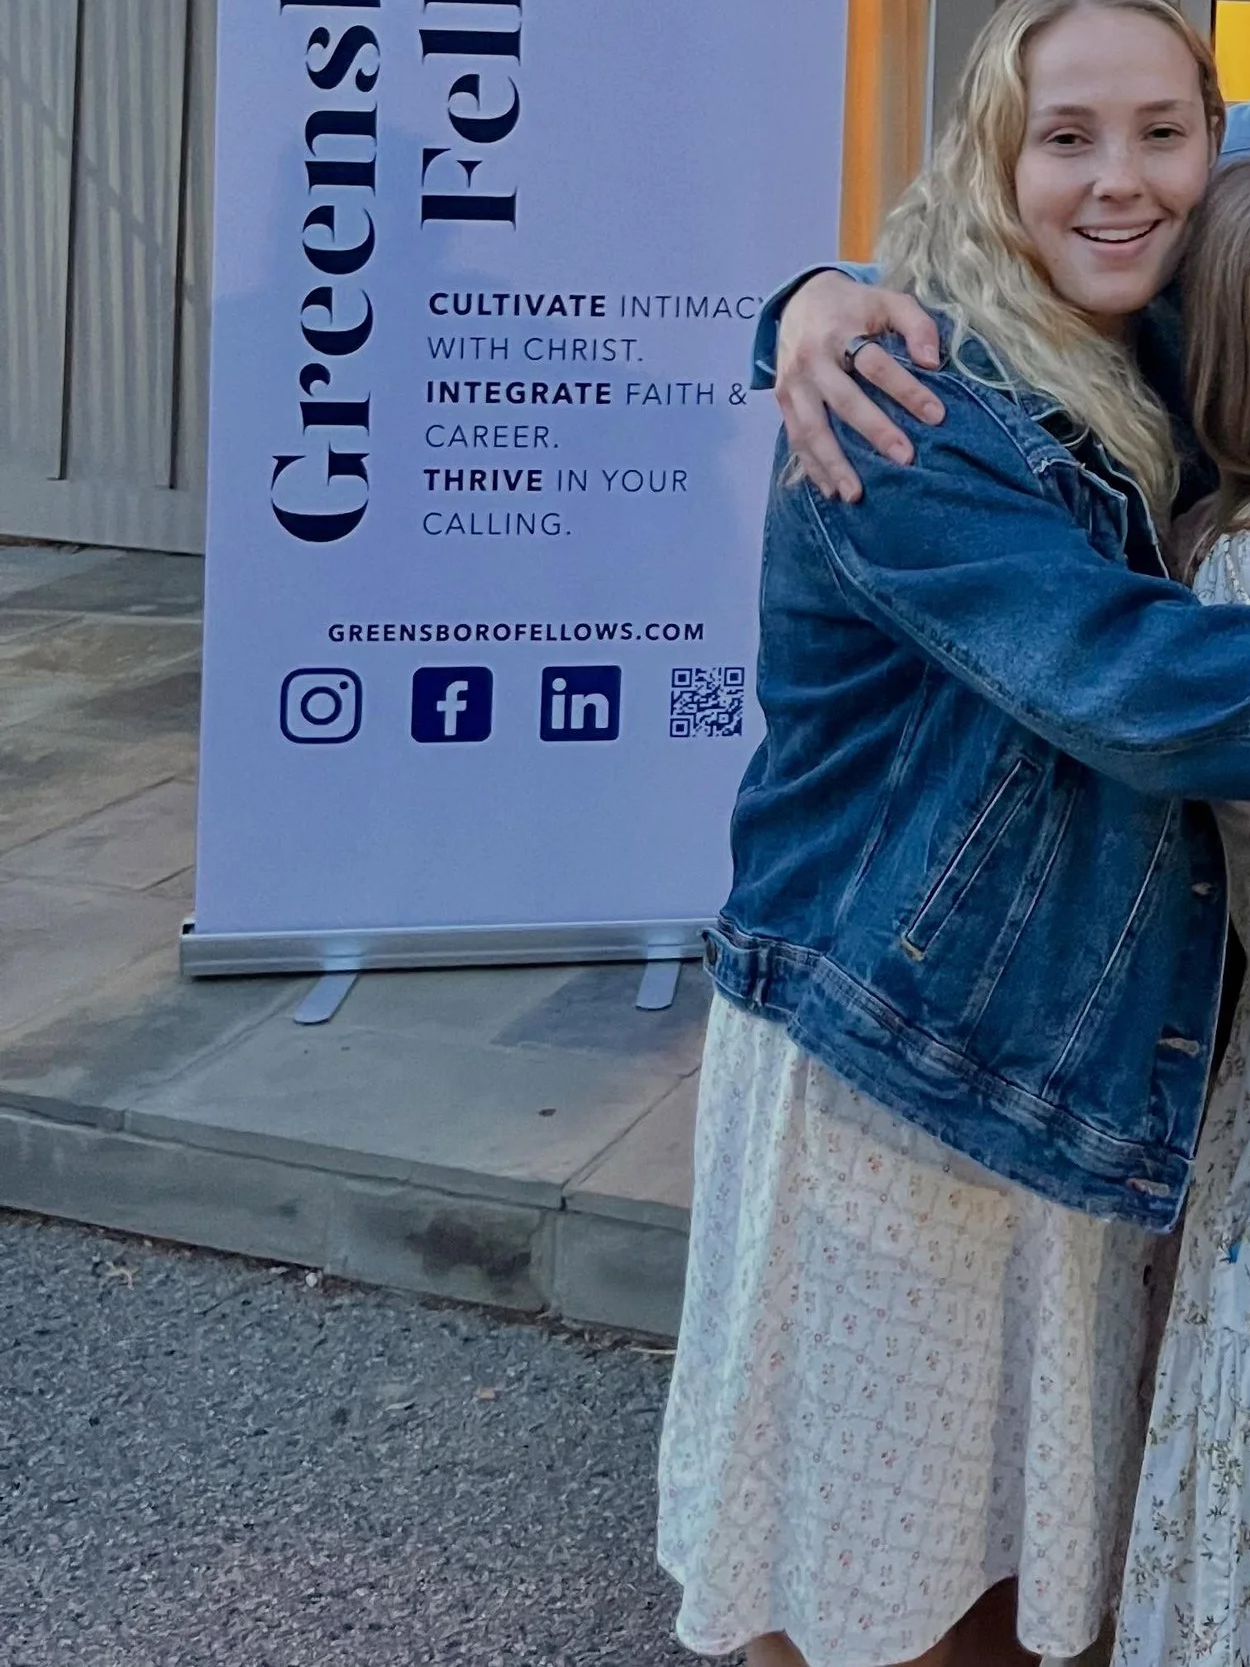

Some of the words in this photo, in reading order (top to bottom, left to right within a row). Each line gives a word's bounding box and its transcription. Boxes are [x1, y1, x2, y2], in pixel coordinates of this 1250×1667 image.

[428, 292, 606, 317] CULTIVATE
[620, 295, 764, 320] INTIMAC
[427, 336, 509, 360] WITH
[523, 337, 643, 362] CHRIST.
[426, 381, 611, 405] INTEGRATE
[626, 383, 714, 406] FAITH
[728, 383, 748, 405] &
[425, 424, 559, 449] CAREER.
[424, 469, 543, 492] THRIVE
[557, 470, 587, 492] IN
[602, 470, 687, 493] YOUR
[423, 512, 571, 536] CALLING.
[328, 622, 705, 643] GREENSBOROFELLOWS.COM
[551, 677, 610, 730] in
